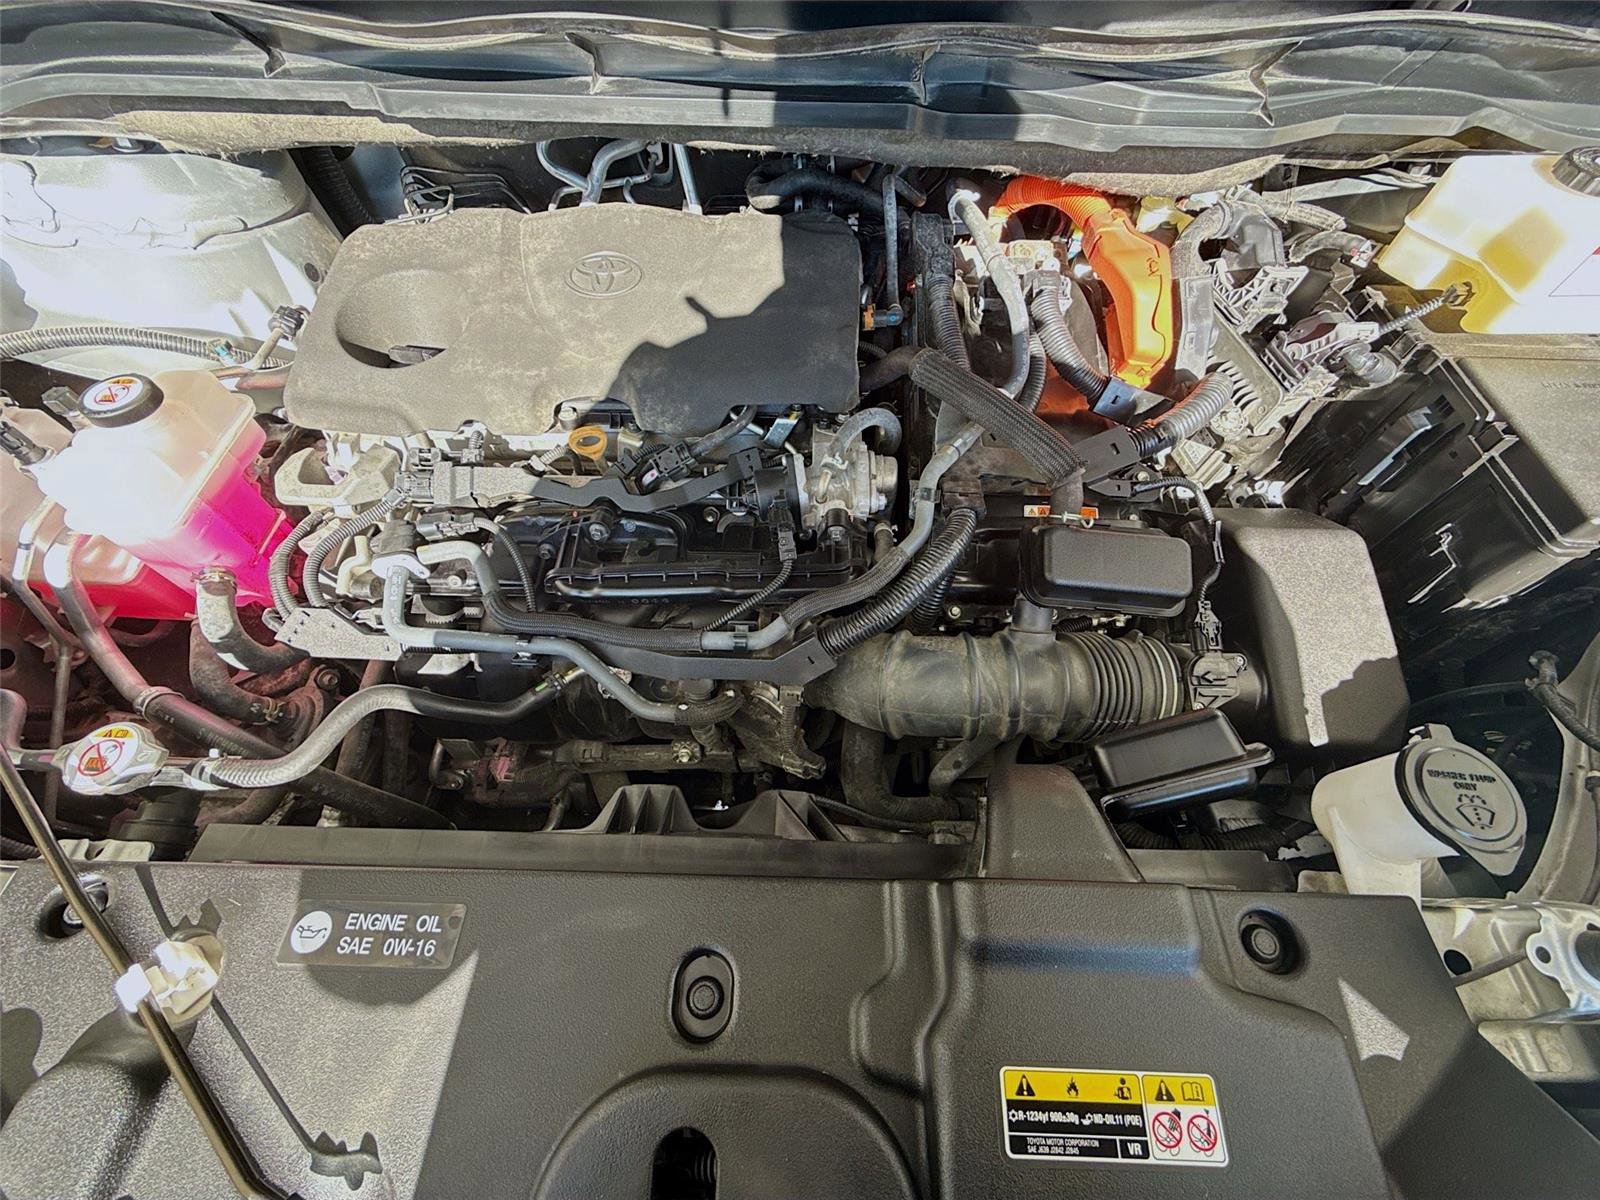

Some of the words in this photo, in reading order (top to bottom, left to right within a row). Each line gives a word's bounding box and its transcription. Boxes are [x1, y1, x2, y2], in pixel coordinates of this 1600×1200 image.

[344, 913, 408, 932] ENGINE
[416, 915, 443, 933] OIL
[336, 936, 374, 955] SAE
[383, 938, 437, 957] 0W-16
[1124, 1114, 1143, 1127] (POE)
[1026, 1137, 1046, 1146] TOYOTA
[1046, 1138, 1064, 1147] MOTOR
[1064, 1138, 1100, 1148] CORPORATION
[1127, 1142, 1143, 1156] VR
[1027, 1145, 1037, 1154] SAE
